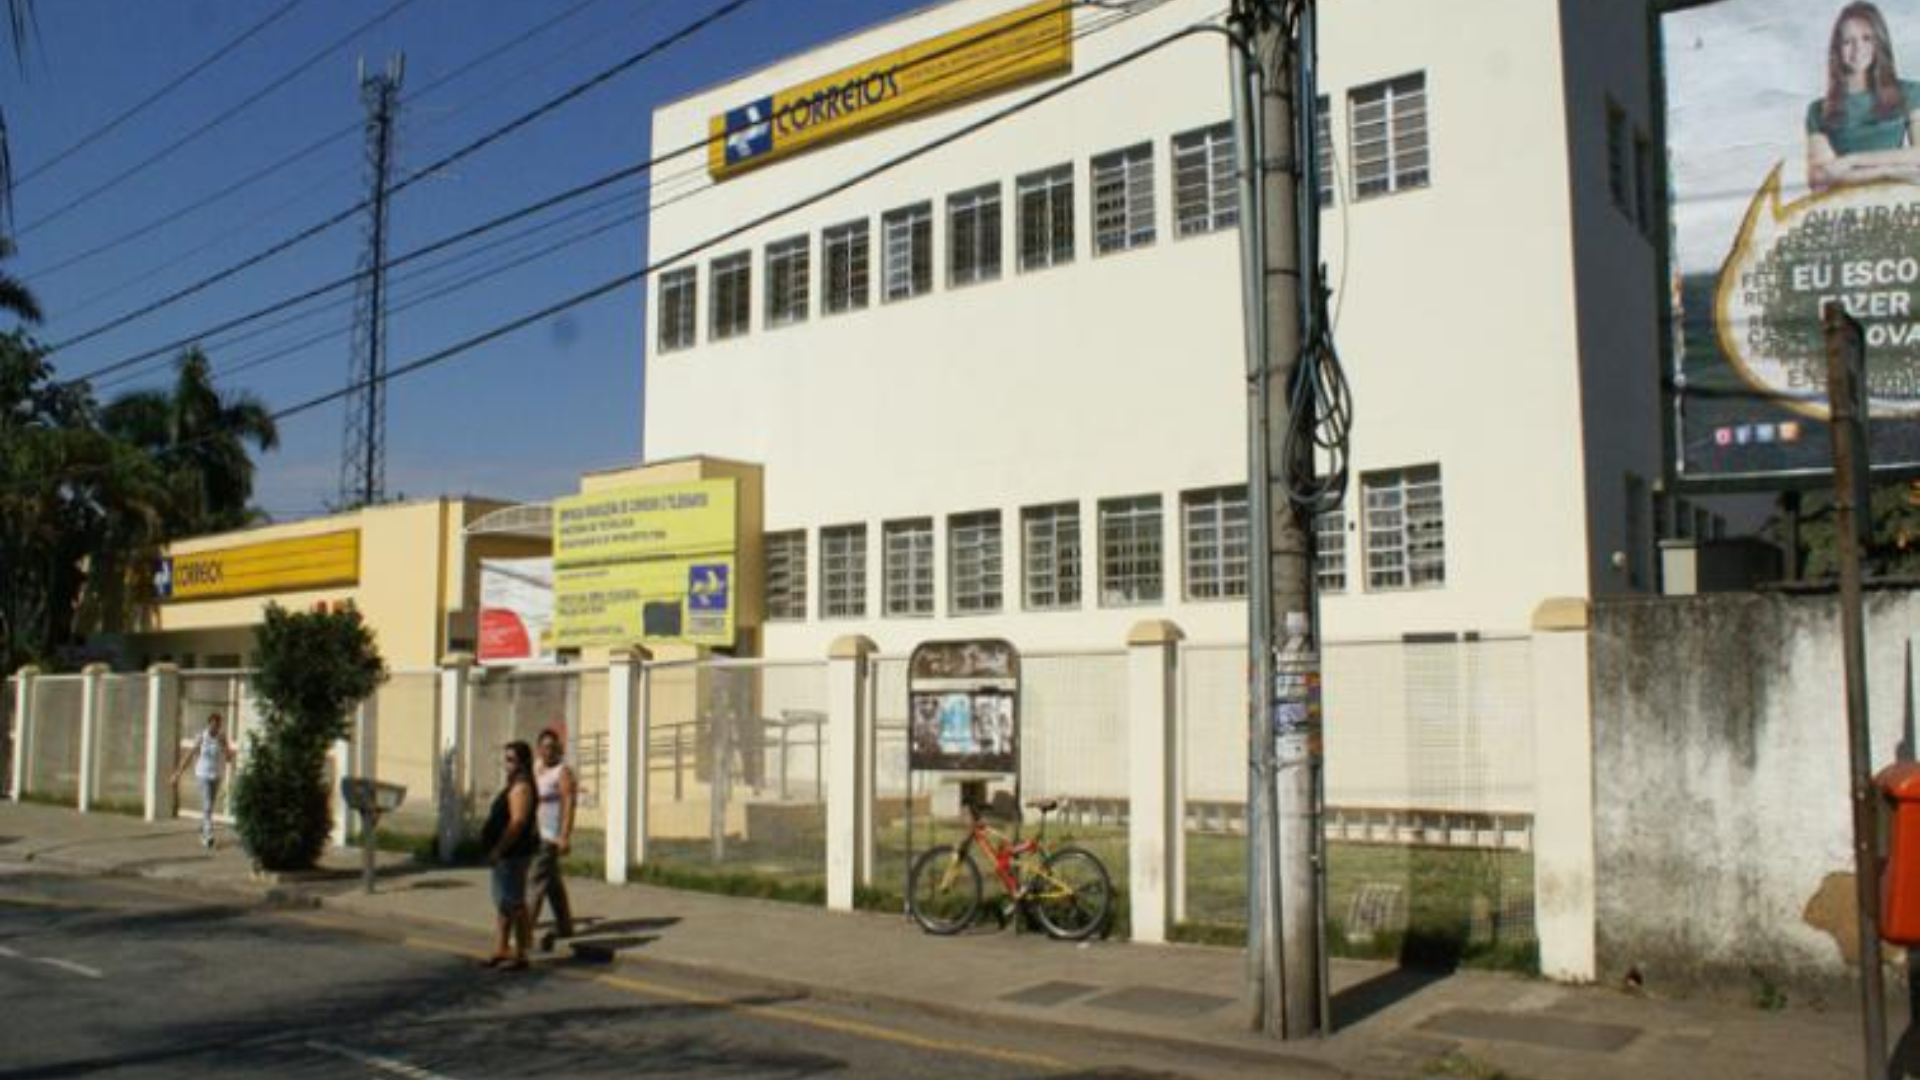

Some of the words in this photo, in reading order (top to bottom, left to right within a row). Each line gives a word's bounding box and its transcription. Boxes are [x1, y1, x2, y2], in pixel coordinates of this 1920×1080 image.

[777, 64, 898, 135] CORREIOS
[1793, 264, 1833, 291] EU
[1842, 256, 1919, 288] ESCO
[1866, 322, 1920, 347] OVA
